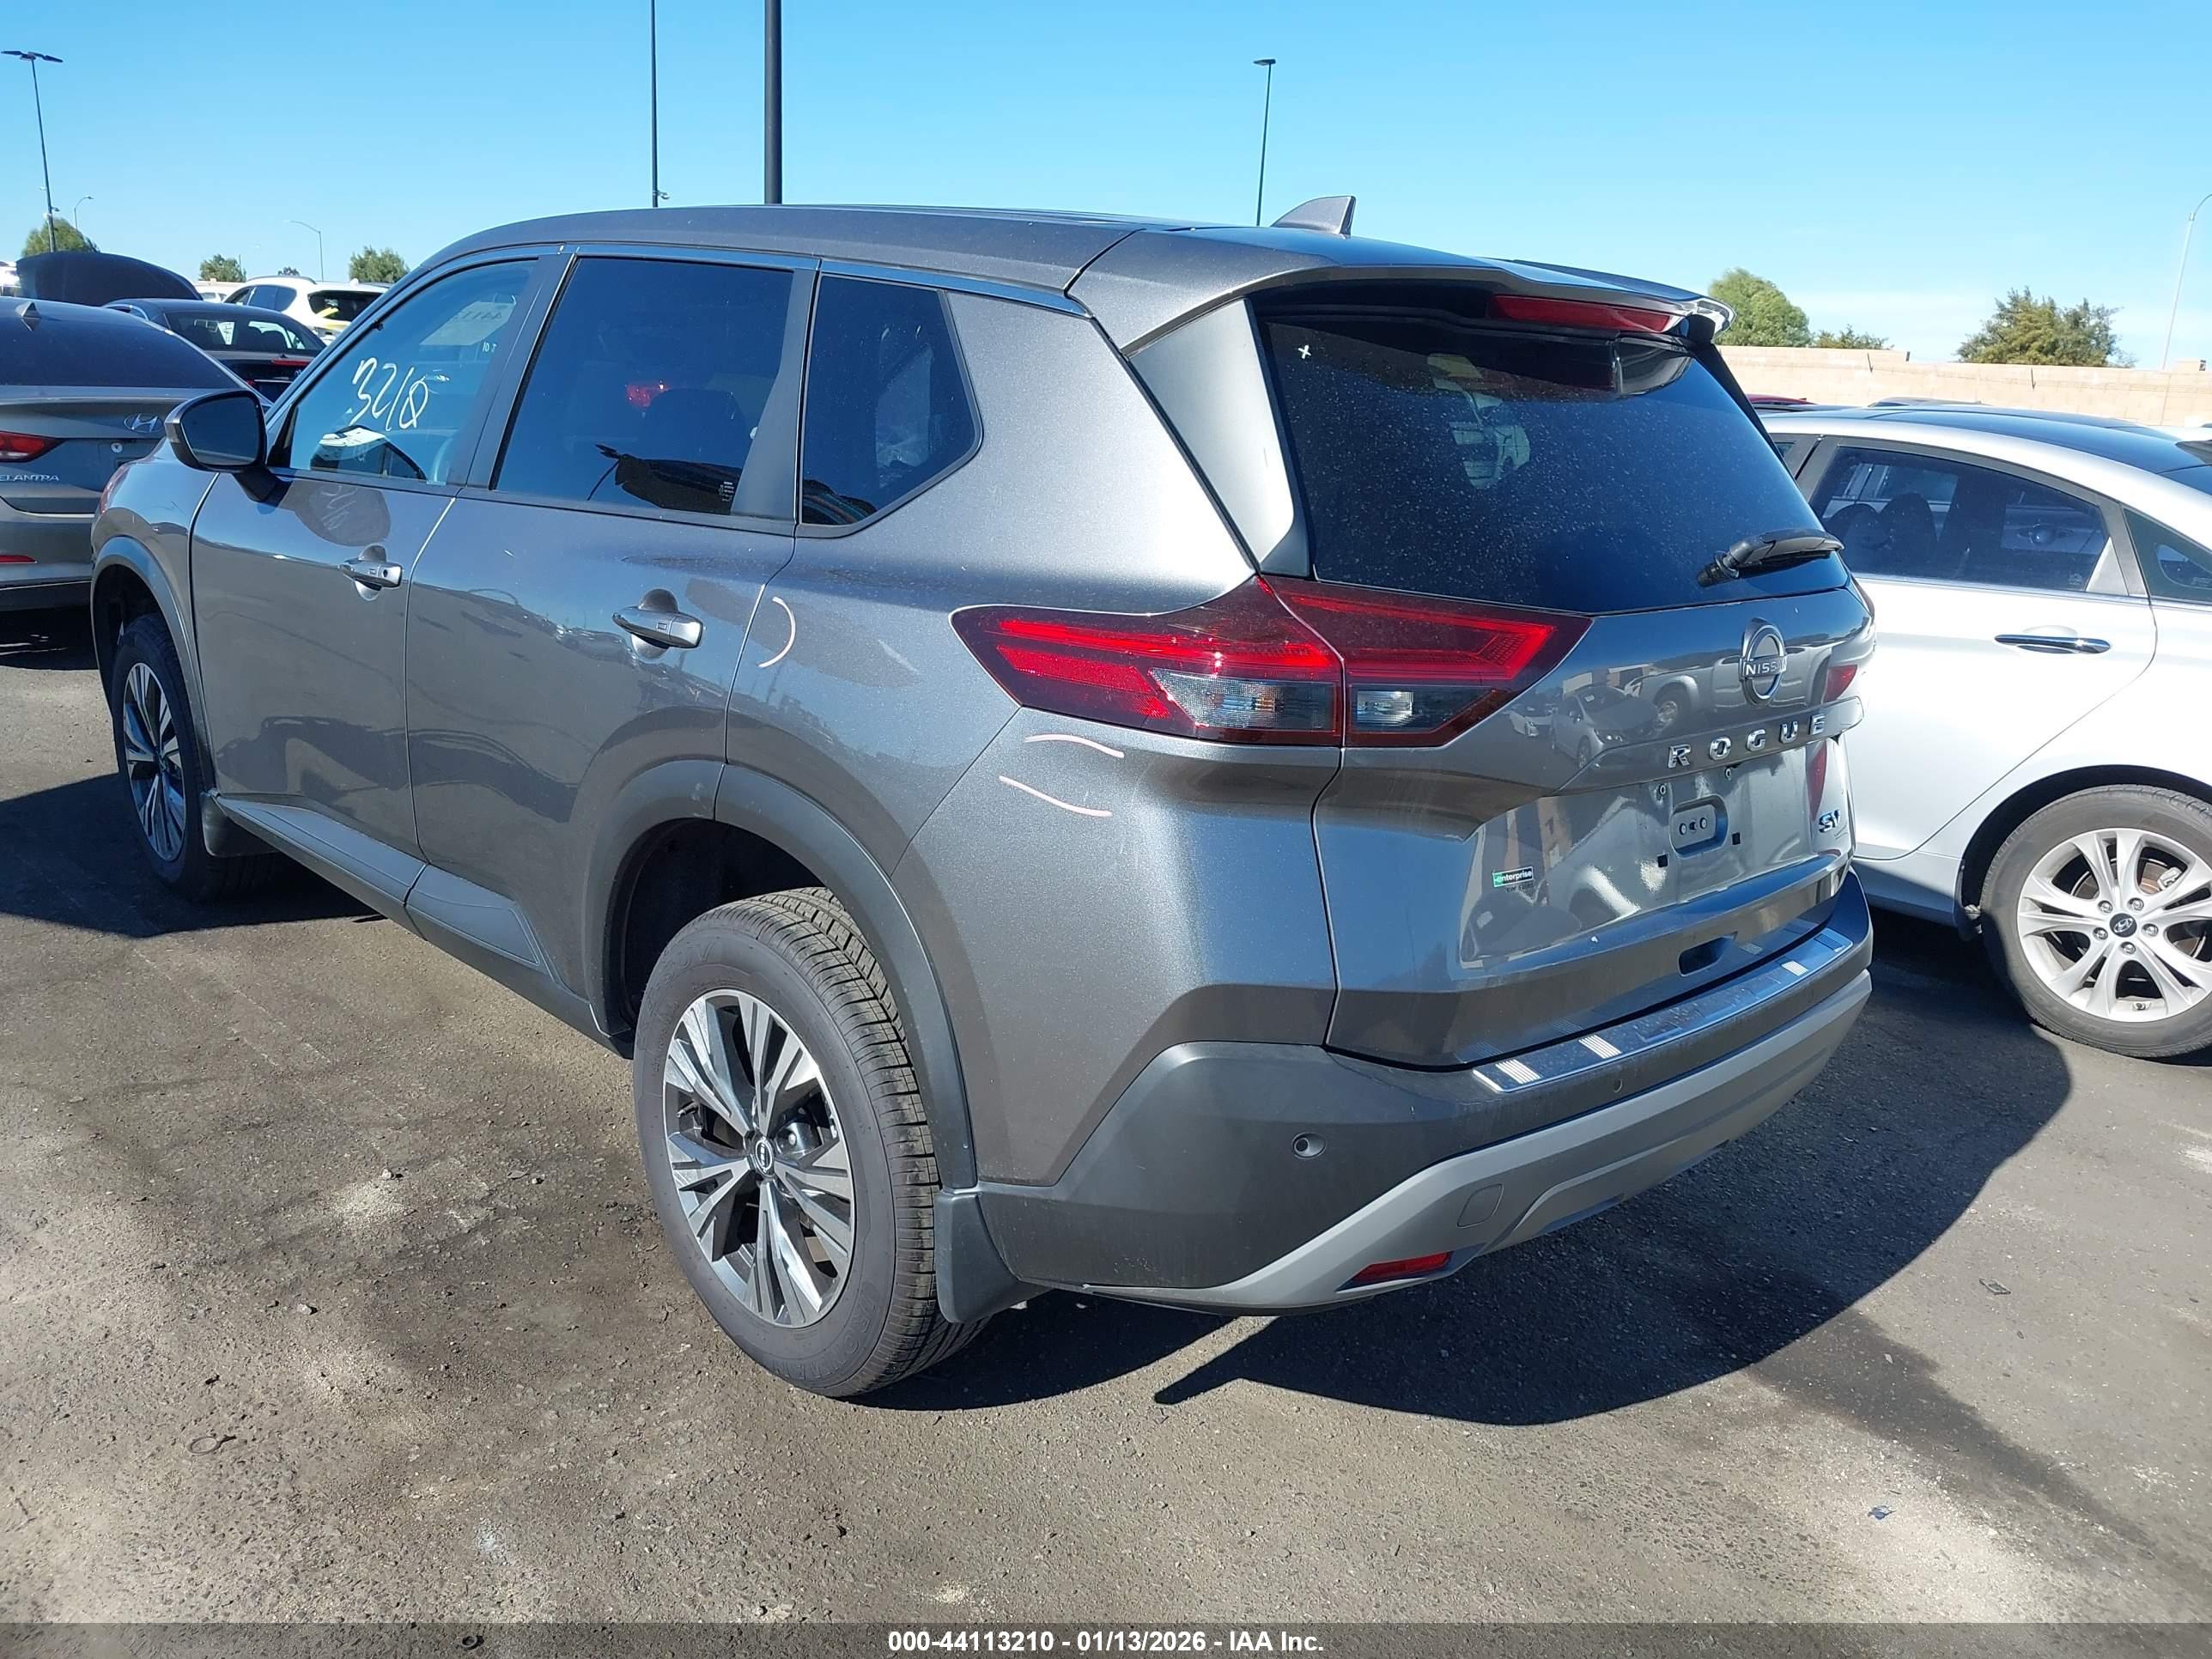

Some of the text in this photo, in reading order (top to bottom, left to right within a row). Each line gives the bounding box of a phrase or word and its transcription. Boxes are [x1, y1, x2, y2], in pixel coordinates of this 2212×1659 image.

[1744, 658, 1786, 677] NISS
[1668, 714, 1826, 769] ROGUE
[1819, 810, 1841, 833] SV
[1495, 869, 1532, 883] enterprise
